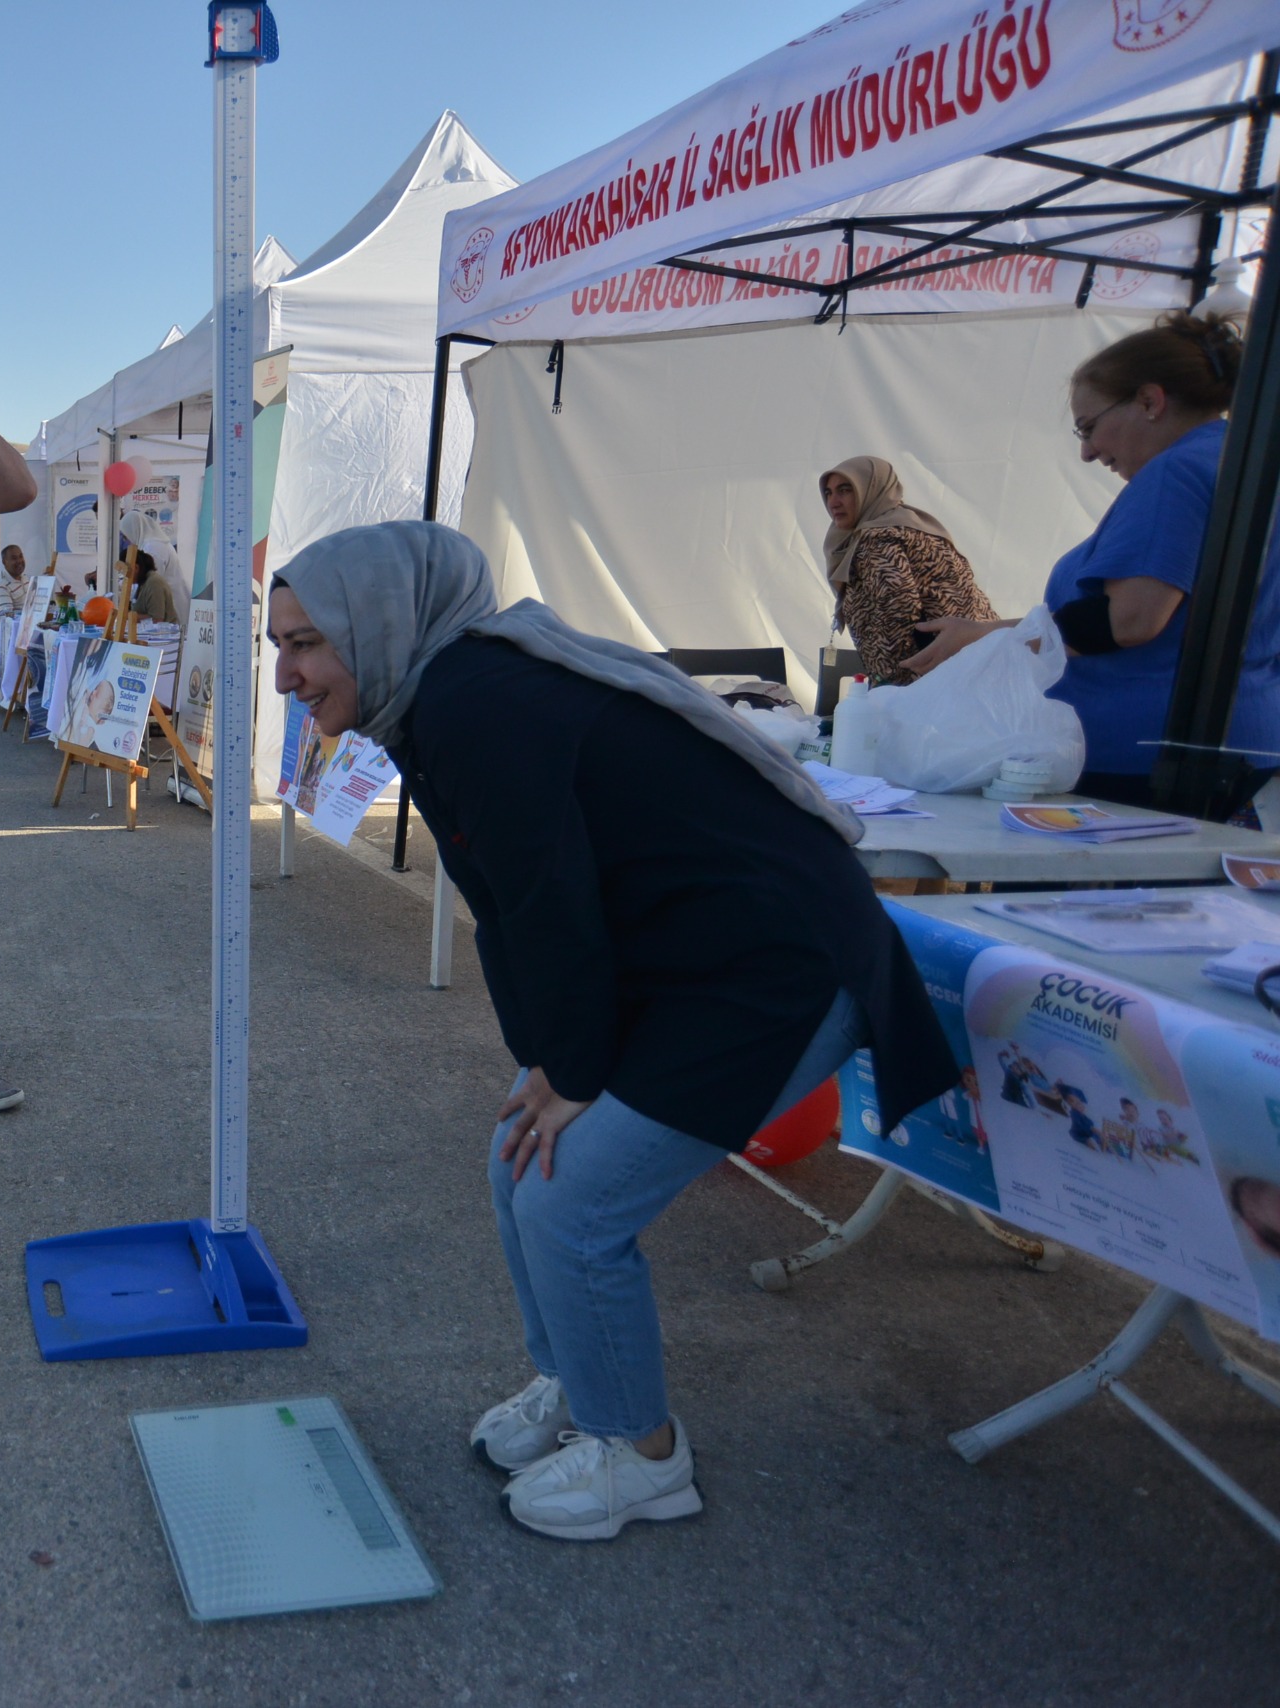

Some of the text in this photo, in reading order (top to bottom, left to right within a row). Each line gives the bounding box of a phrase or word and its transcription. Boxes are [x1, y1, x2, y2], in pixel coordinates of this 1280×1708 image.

[500, 0, 1052, 280] AFYONKARAHİSAR İL SAĞLIK MÜDÜRLÜĞÜ
[144, 486, 167, 494] BEBEK
[124, 657, 150, 669] ANNELER
[120, 691, 138, 702] Sadece
[117, 702, 136, 713] Emzirin
[1039, 972, 1138, 1019] ÇOCUK
[1031, 996, 1118, 1041] AKADEMİSİ
